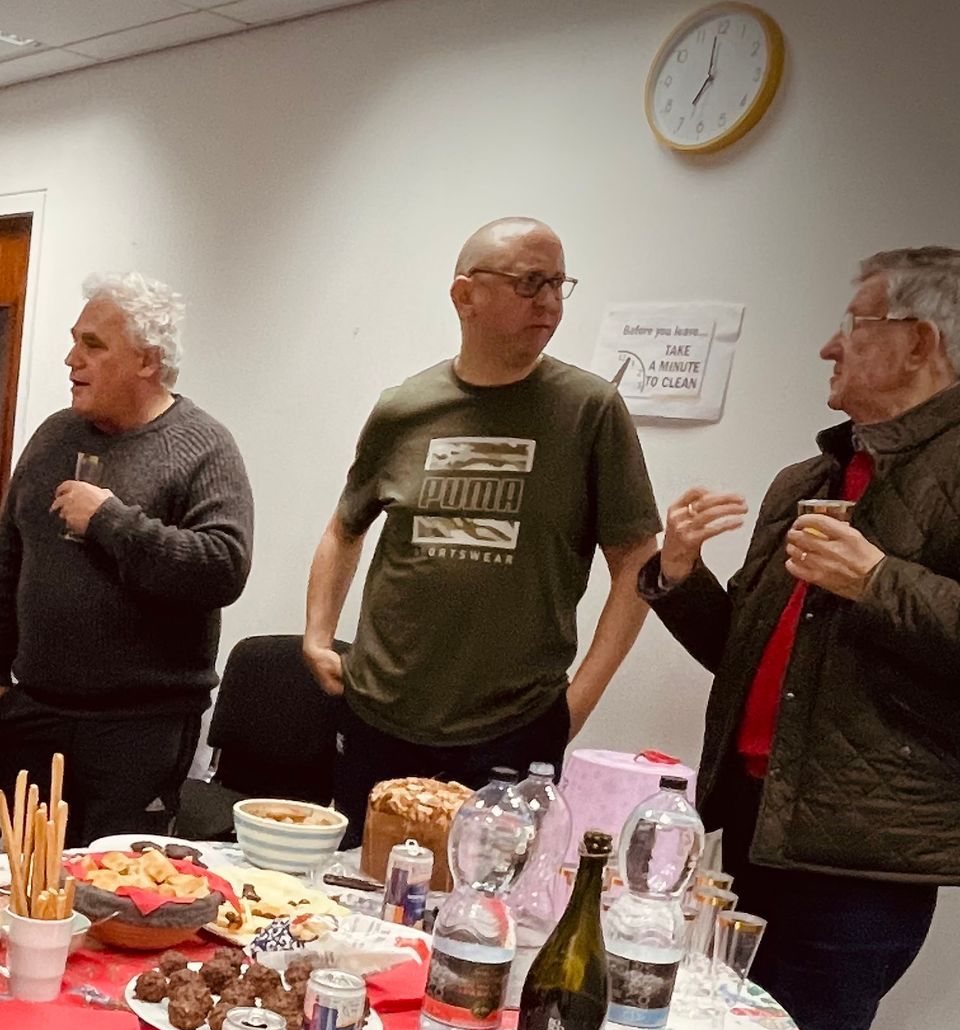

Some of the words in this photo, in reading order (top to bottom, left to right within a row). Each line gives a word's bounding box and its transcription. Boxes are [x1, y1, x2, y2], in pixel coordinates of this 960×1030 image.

[623, 324, 653, 336] Before
[655, 327, 672, 338] you
[665, 344, 691, 356] TAKE
[649, 360, 656, 371] A
[659, 361, 701, 373] MINUTE
[646, 375, 658, 388] TO
[662, 377, 697, 389] CLEAN
[427, 547, 514, 564] ORTSWEAR
